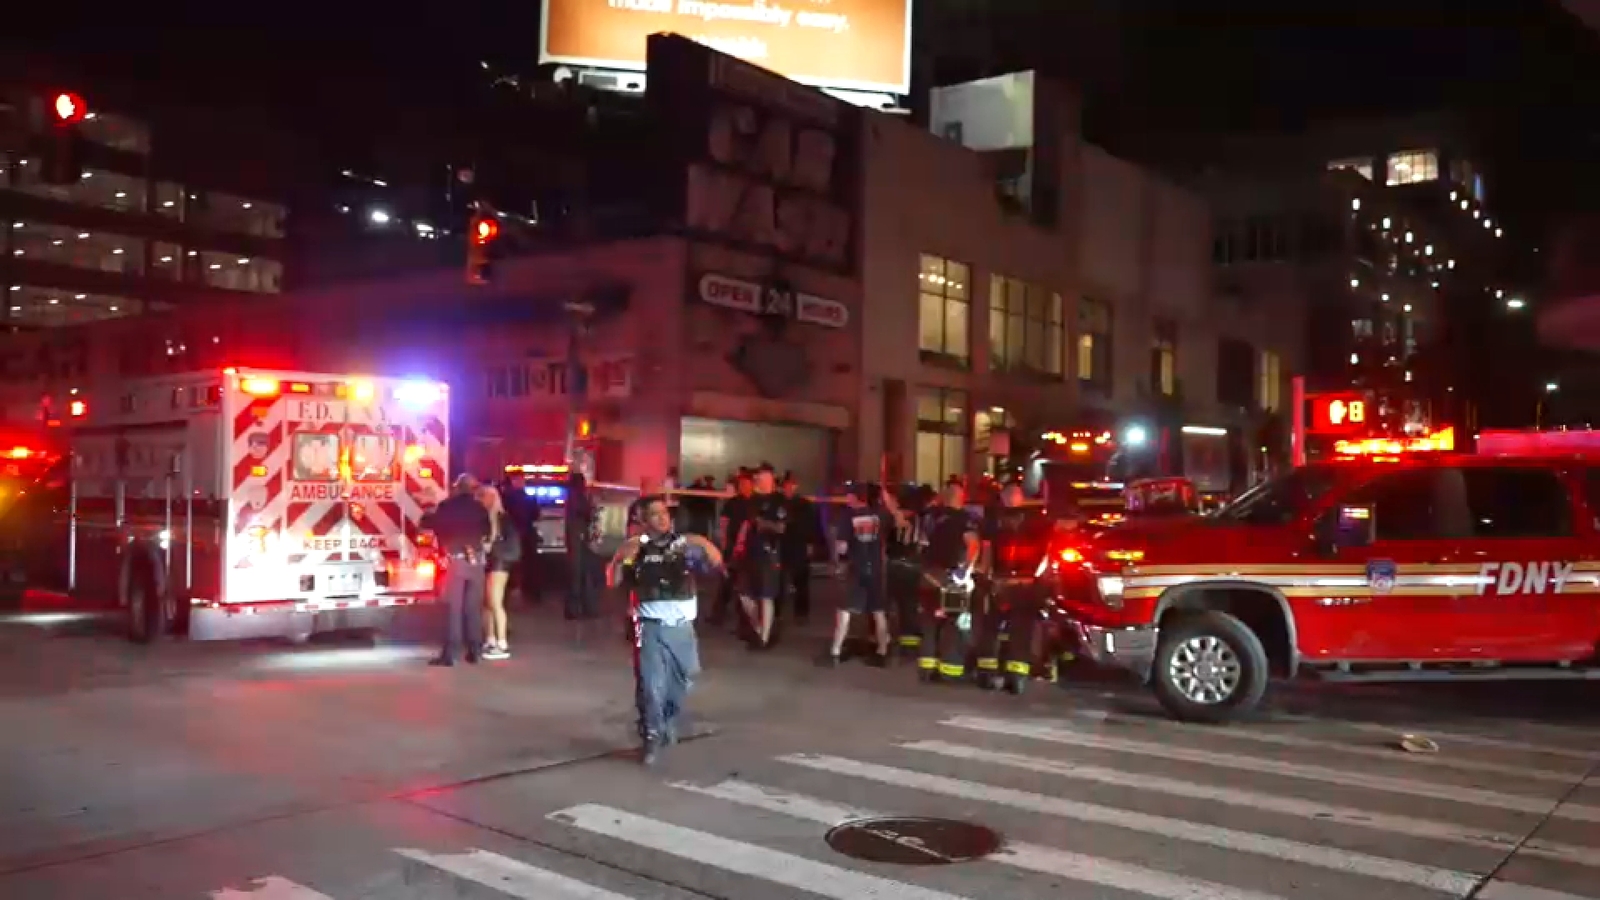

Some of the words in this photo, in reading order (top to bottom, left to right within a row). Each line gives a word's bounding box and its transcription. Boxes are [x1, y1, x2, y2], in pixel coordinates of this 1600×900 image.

[677, 0, 792, 28] impossibly
[707, 280, 754, 304] OPEN
[764, 287, 792, 317] 24
[290, 483, 394, 501] AMBULANCE
[303, 538, 343, 551] KEEP
[350, 537, 388, 550] BACK
[1476, 561, 1574, 596] FDNY
